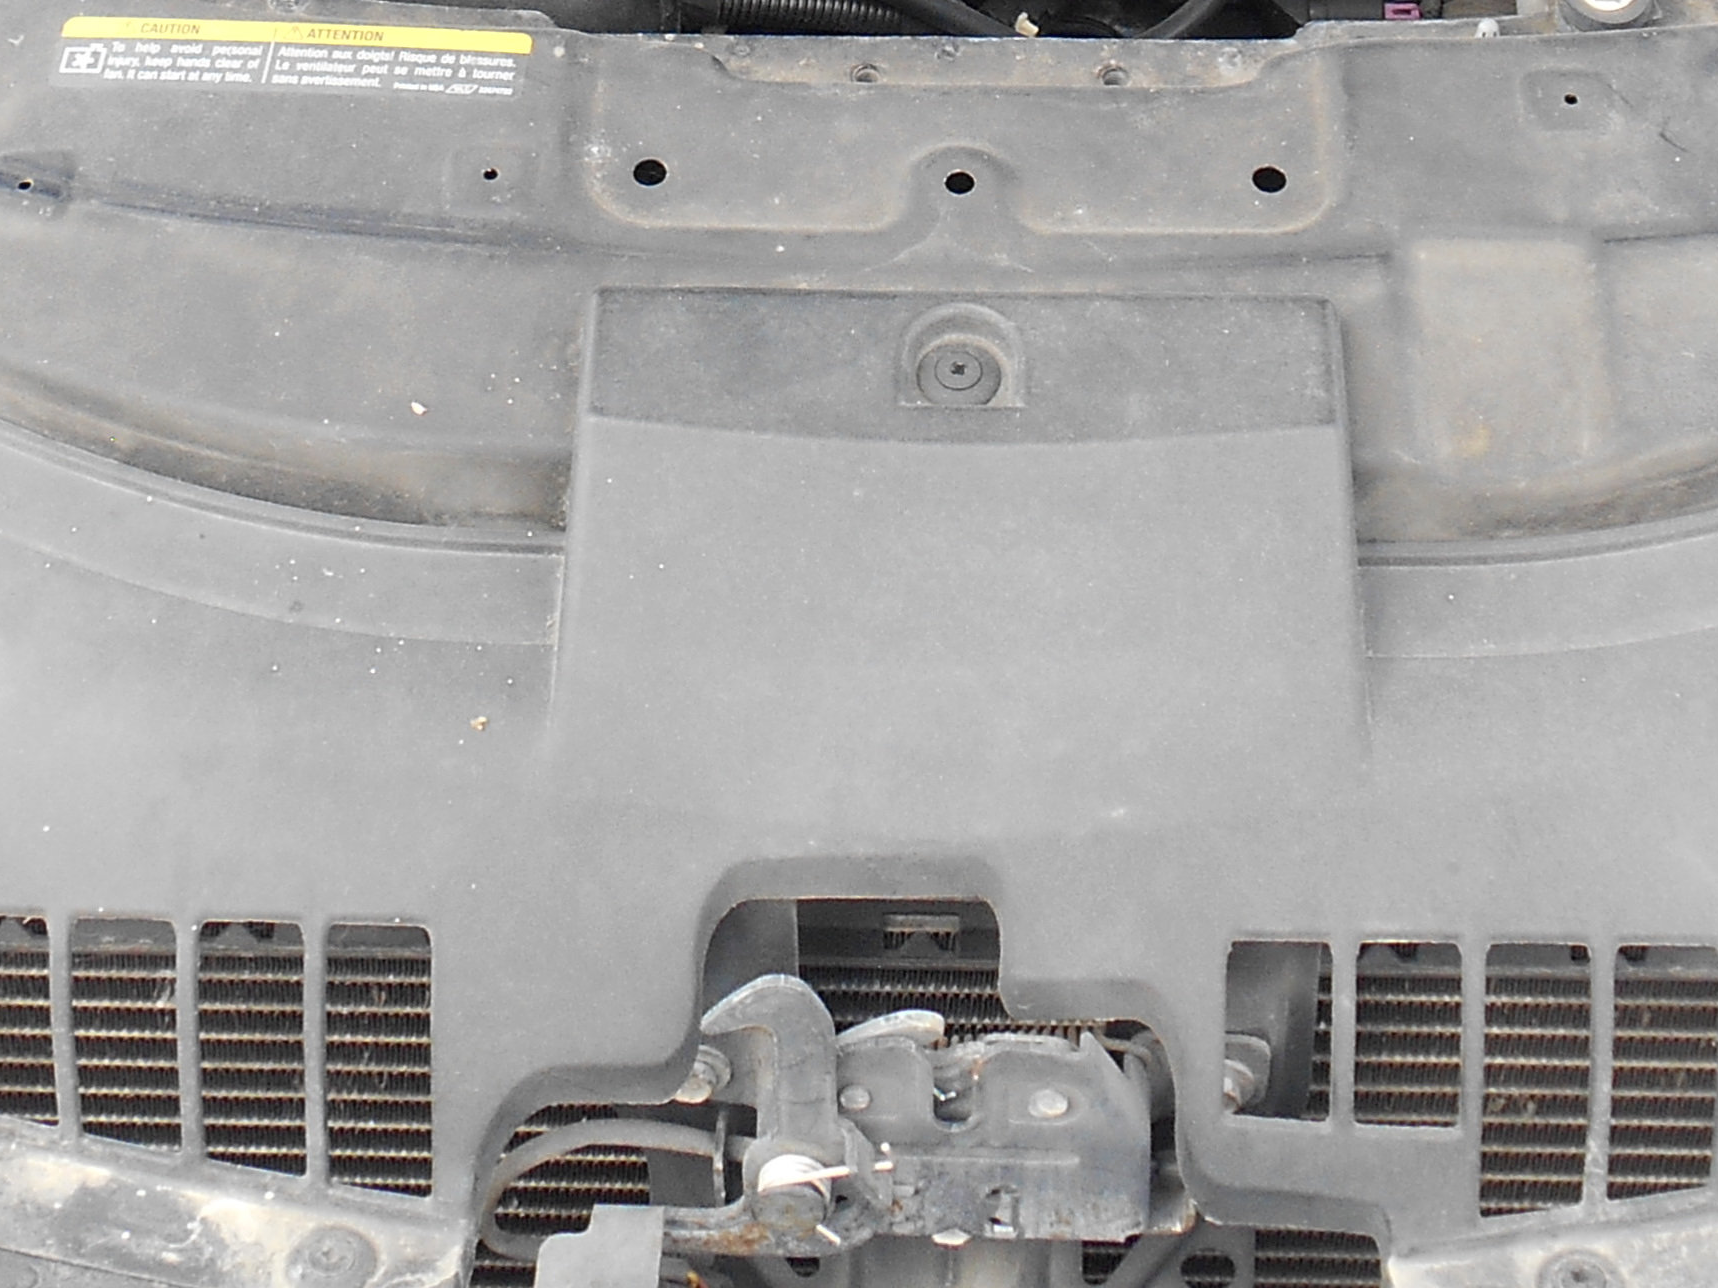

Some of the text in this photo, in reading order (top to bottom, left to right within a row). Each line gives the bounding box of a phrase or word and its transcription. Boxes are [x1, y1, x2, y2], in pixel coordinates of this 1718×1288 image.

[140, 23, 201, 35] CAUTION
[306, 28, 385, 42] ATTENTION
[112, 41, 263, 57] To help avoid personal
[144, 56, 173, 68] keep
[176, 57, 211, 68] hands
[214, 58, 243, 69] clear
[246, 58, 261, 69] of
[277, 46, 516, 68] Attention aux doigts! Risque de blessures.
[137, 70, 158, 80] can
[159, 70, 186, 81] start
[187, 71, 200, 81] at
[201, 72, 223, 83] any
[224, 72, 252, 83] time.
[275, 59, 290, 71] Le
[295, 60, 357, 74] ventilateur
[361, 63, 389, 76] peut
[394, 65, 409, 76] se
[414, 65, 453, 78] mettre
[472, 68, 516, 81] tourner
[271, 72, 382, 88] sans avertissement.
